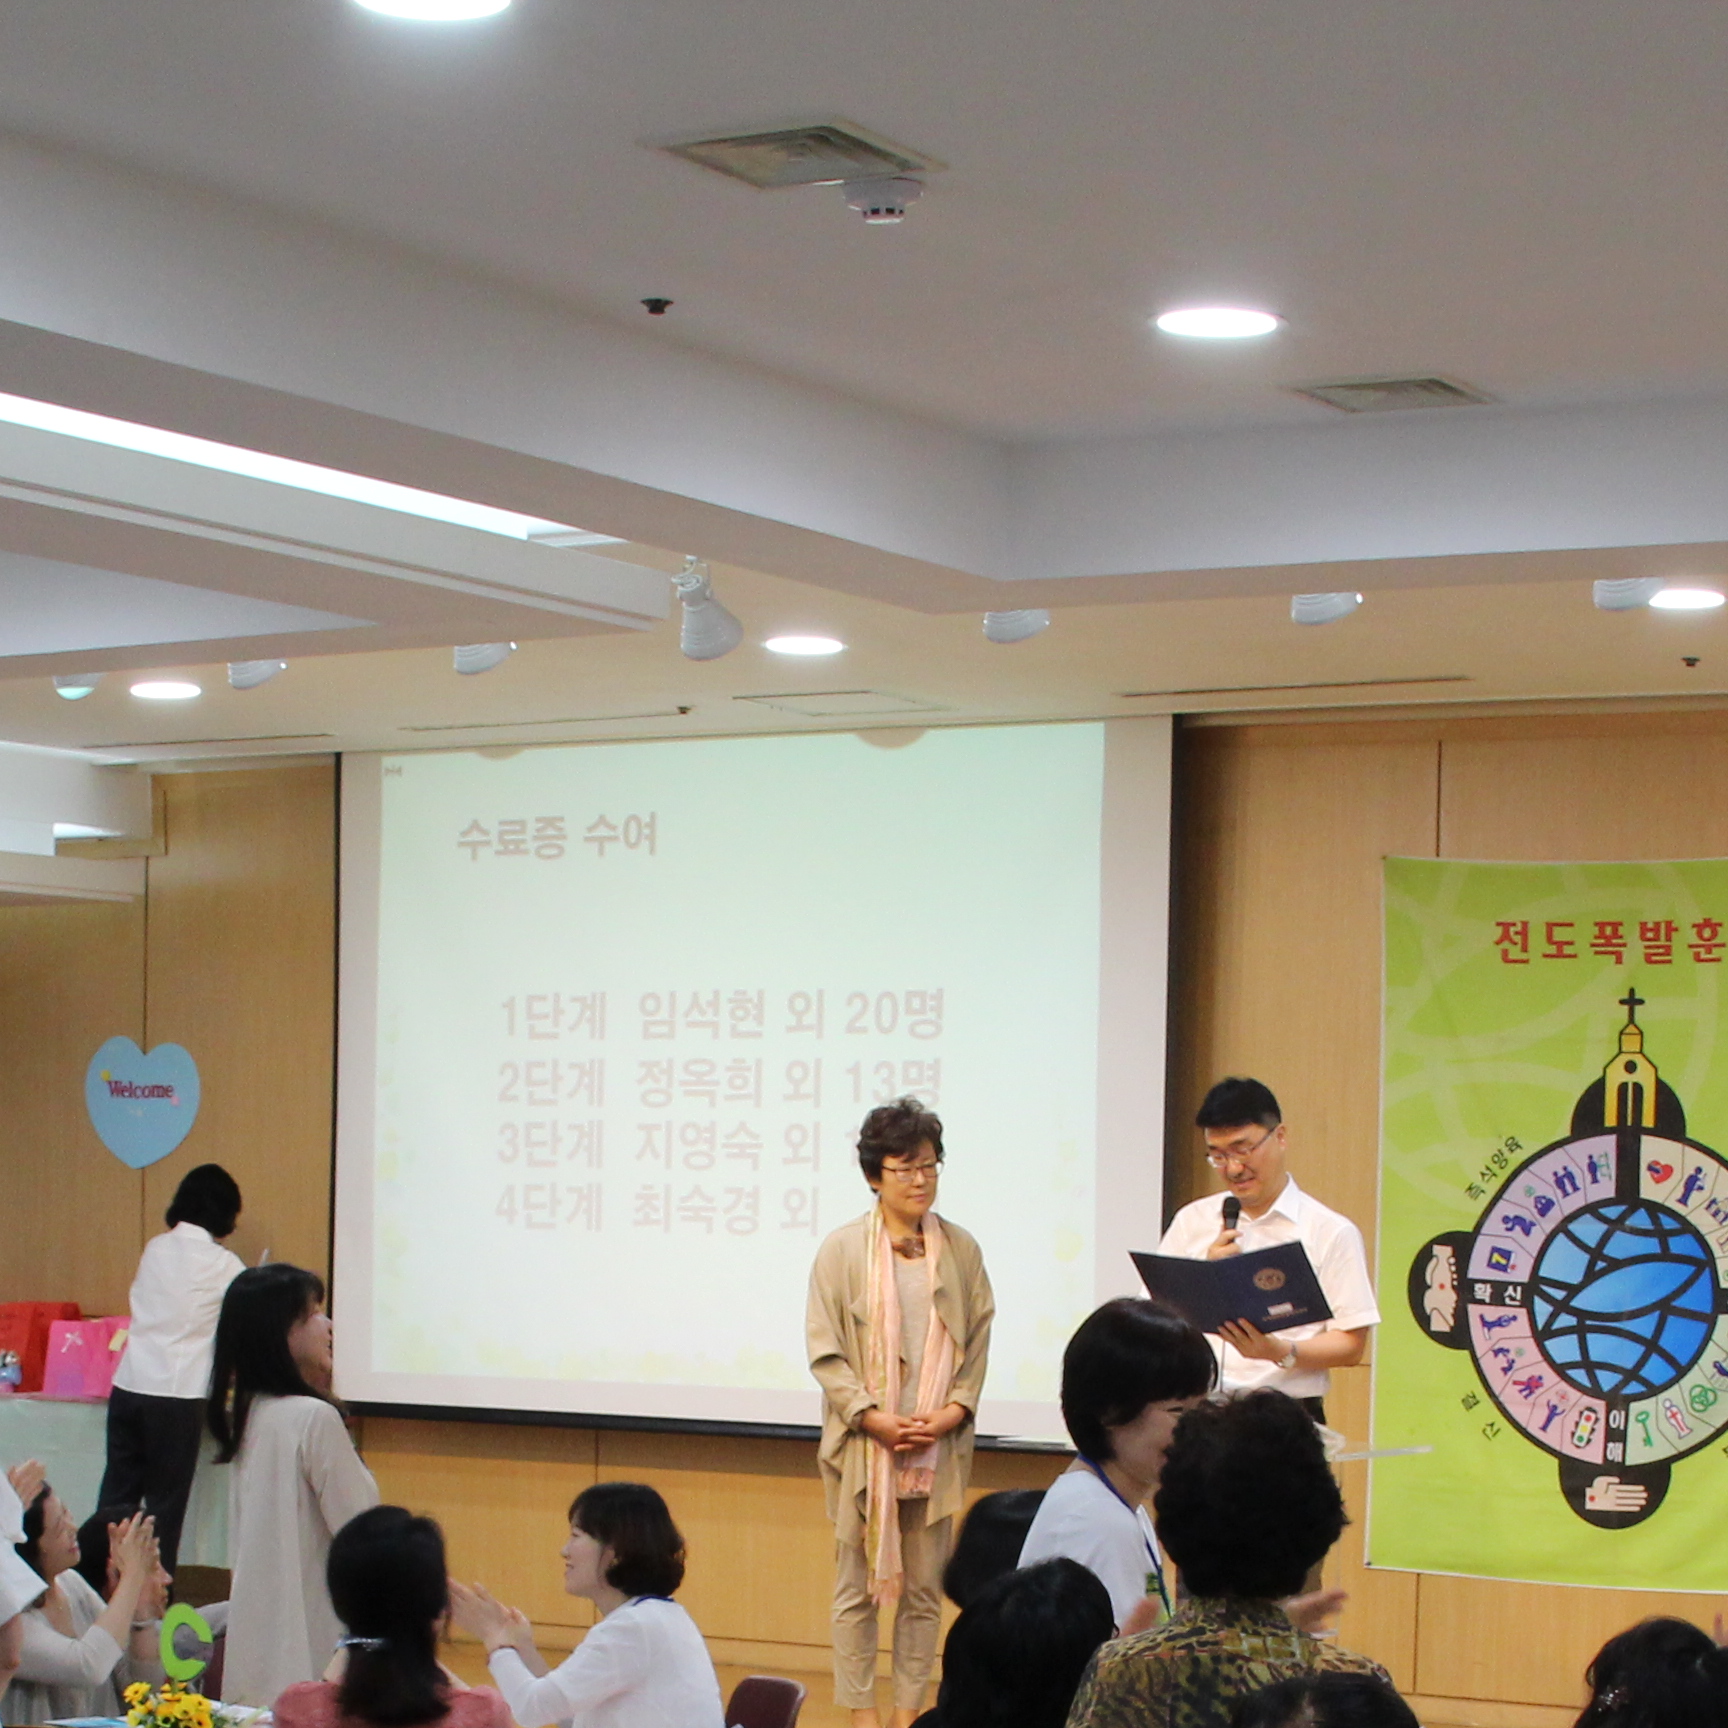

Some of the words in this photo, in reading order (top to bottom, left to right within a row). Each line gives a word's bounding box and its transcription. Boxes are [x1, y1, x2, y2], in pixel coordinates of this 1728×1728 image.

[456, 815, 568, 862] 수료증
[582, 811, 660, 857] 수여
[500, 990, 608, 1041] 1단계
[637, 989, 767, 1041] 임석현
[784, 989, 826, 1040] 외
[844, 987, 947, 1040] 20명
[108, 1080, 174, 1099] Welcome
[497, 1059, 605, 1107] 2단계
[636, 1058, 764, 1109] 정옥희
[783, 1058, 823, 1109] 외
[497, 1120, 604, 1170] 3단계
[635, 1119, 763, 1171] 지영숙
[782, 1121, 822, 1172] 외
[1464, 1135, 1524, 1202] 즉석양육
[495, 1182, 603, 1233] 4단계
[632, 1183, 761, 1236] 최숙경
[780, 1185, 819, 1237] 외
